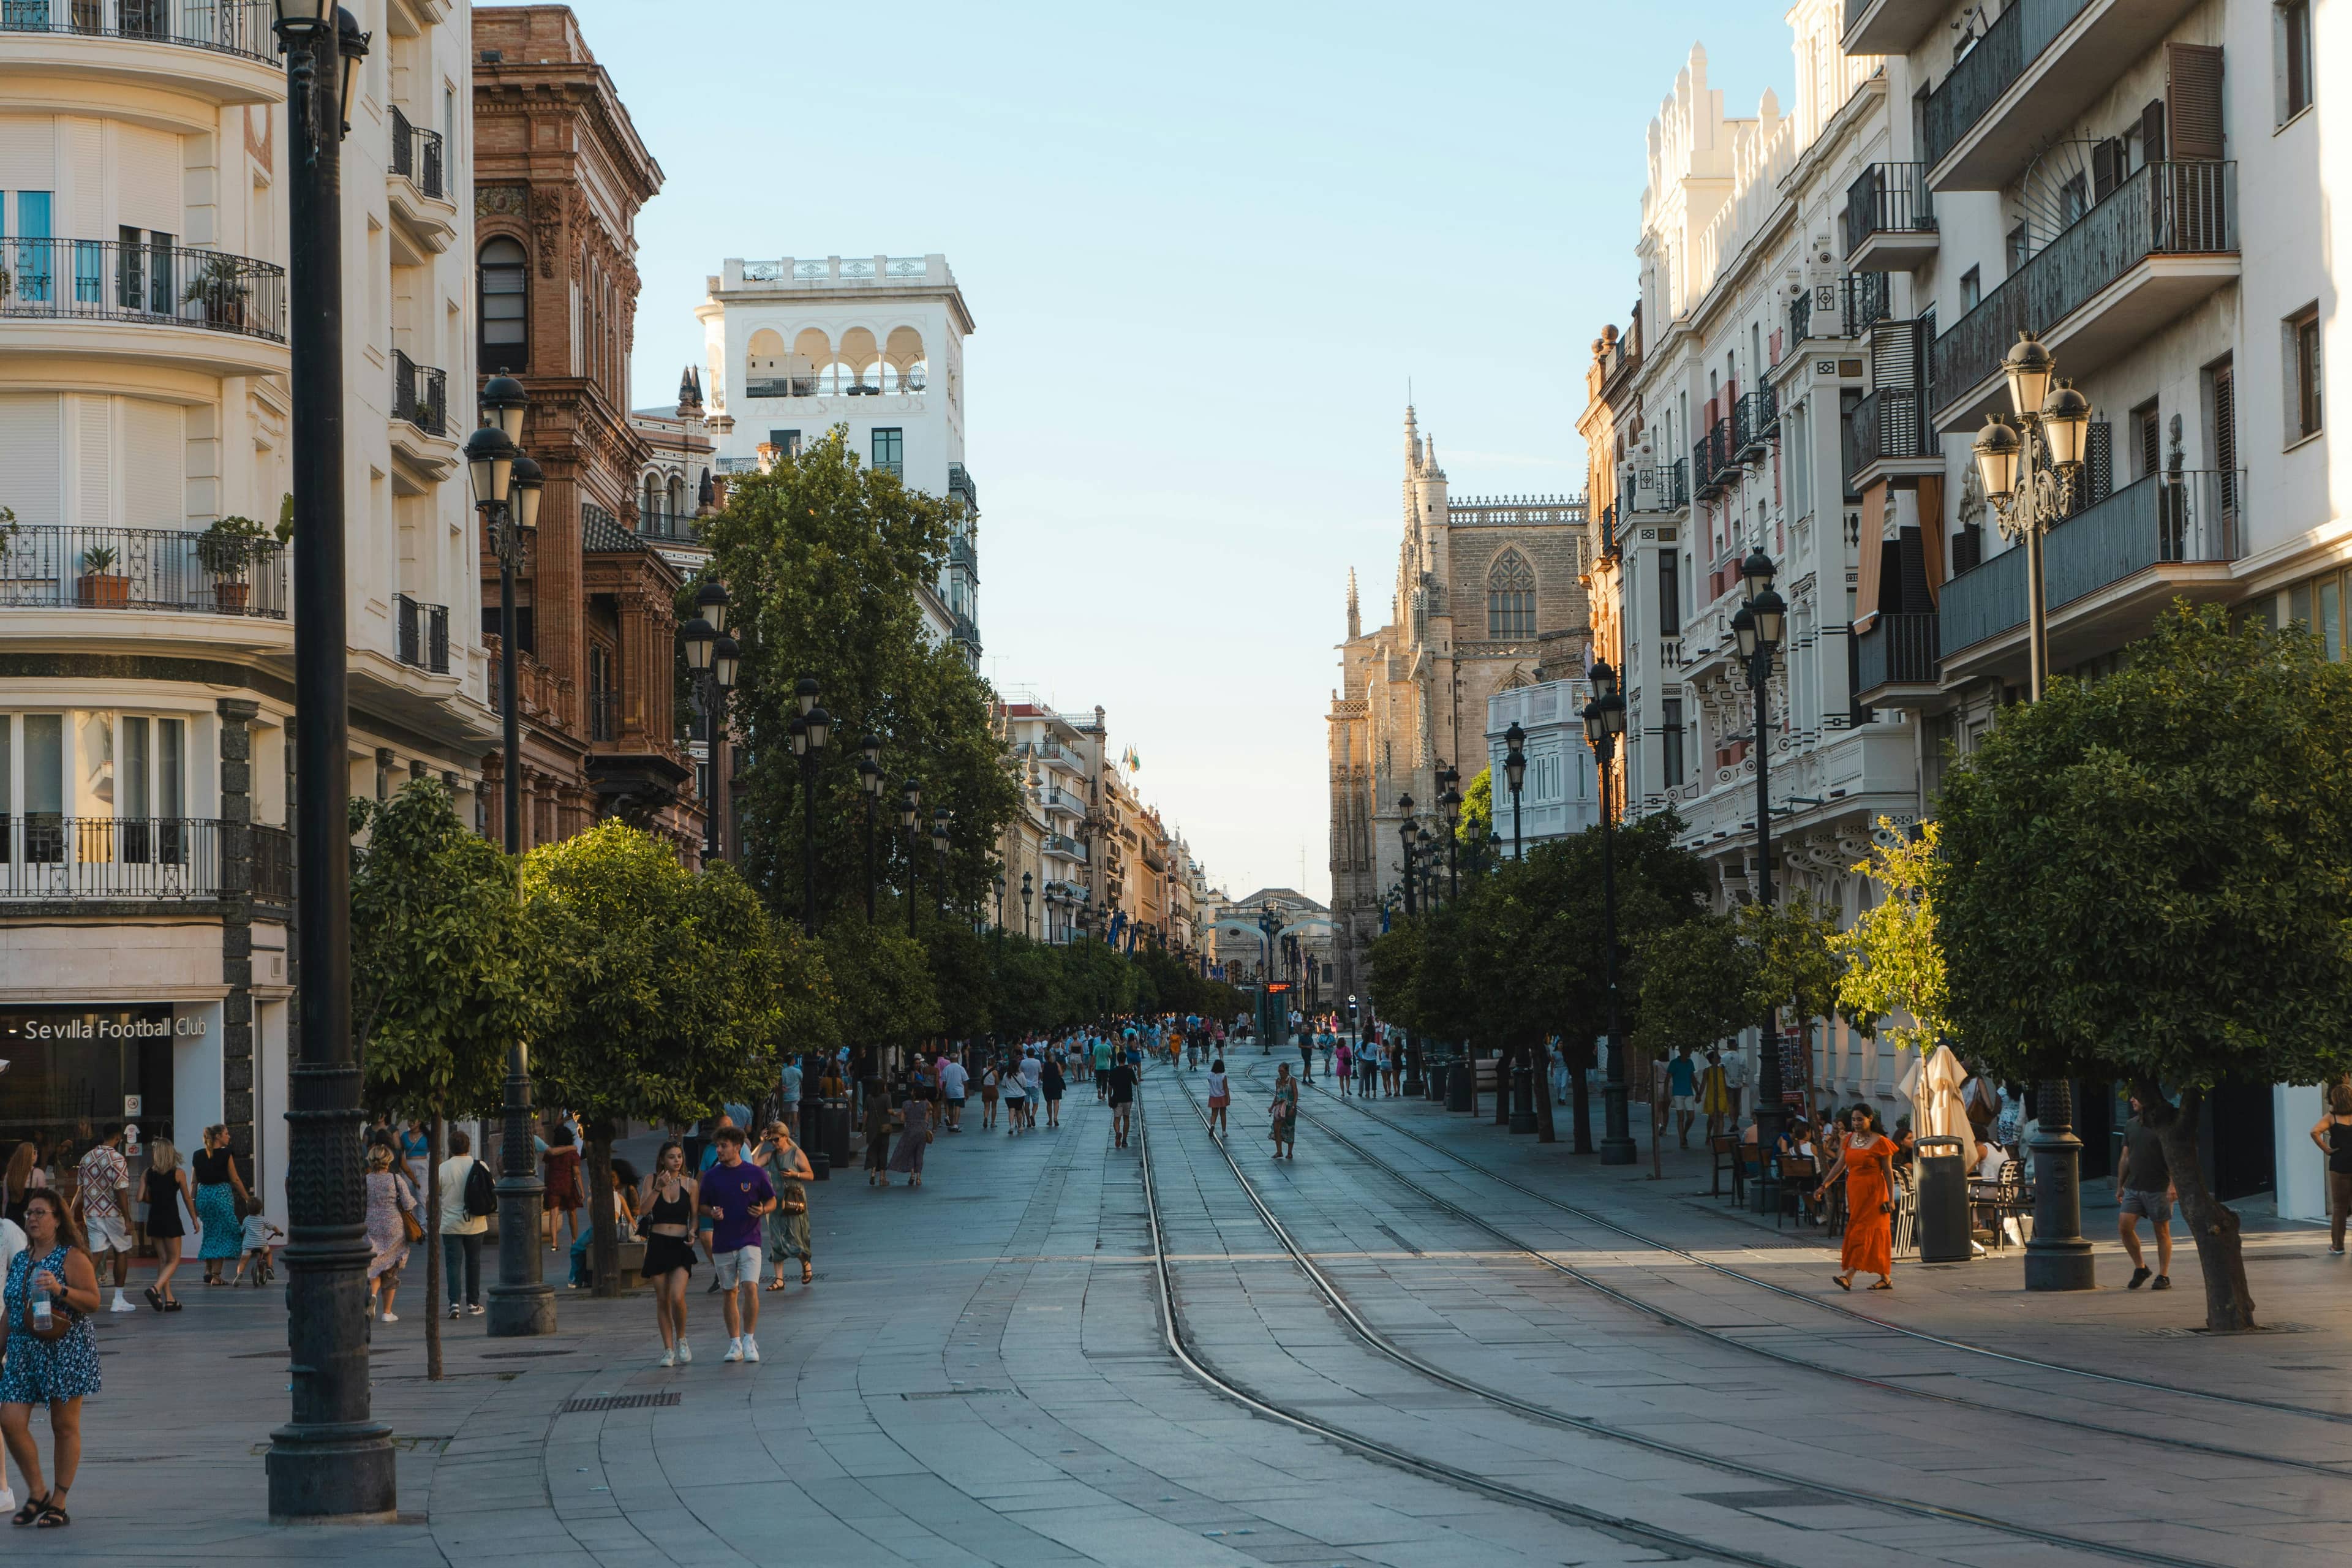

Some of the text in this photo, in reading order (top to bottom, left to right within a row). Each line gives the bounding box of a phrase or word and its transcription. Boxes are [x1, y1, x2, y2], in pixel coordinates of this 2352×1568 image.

[24, 1016, 206, 1039] Sevilla Football Club
